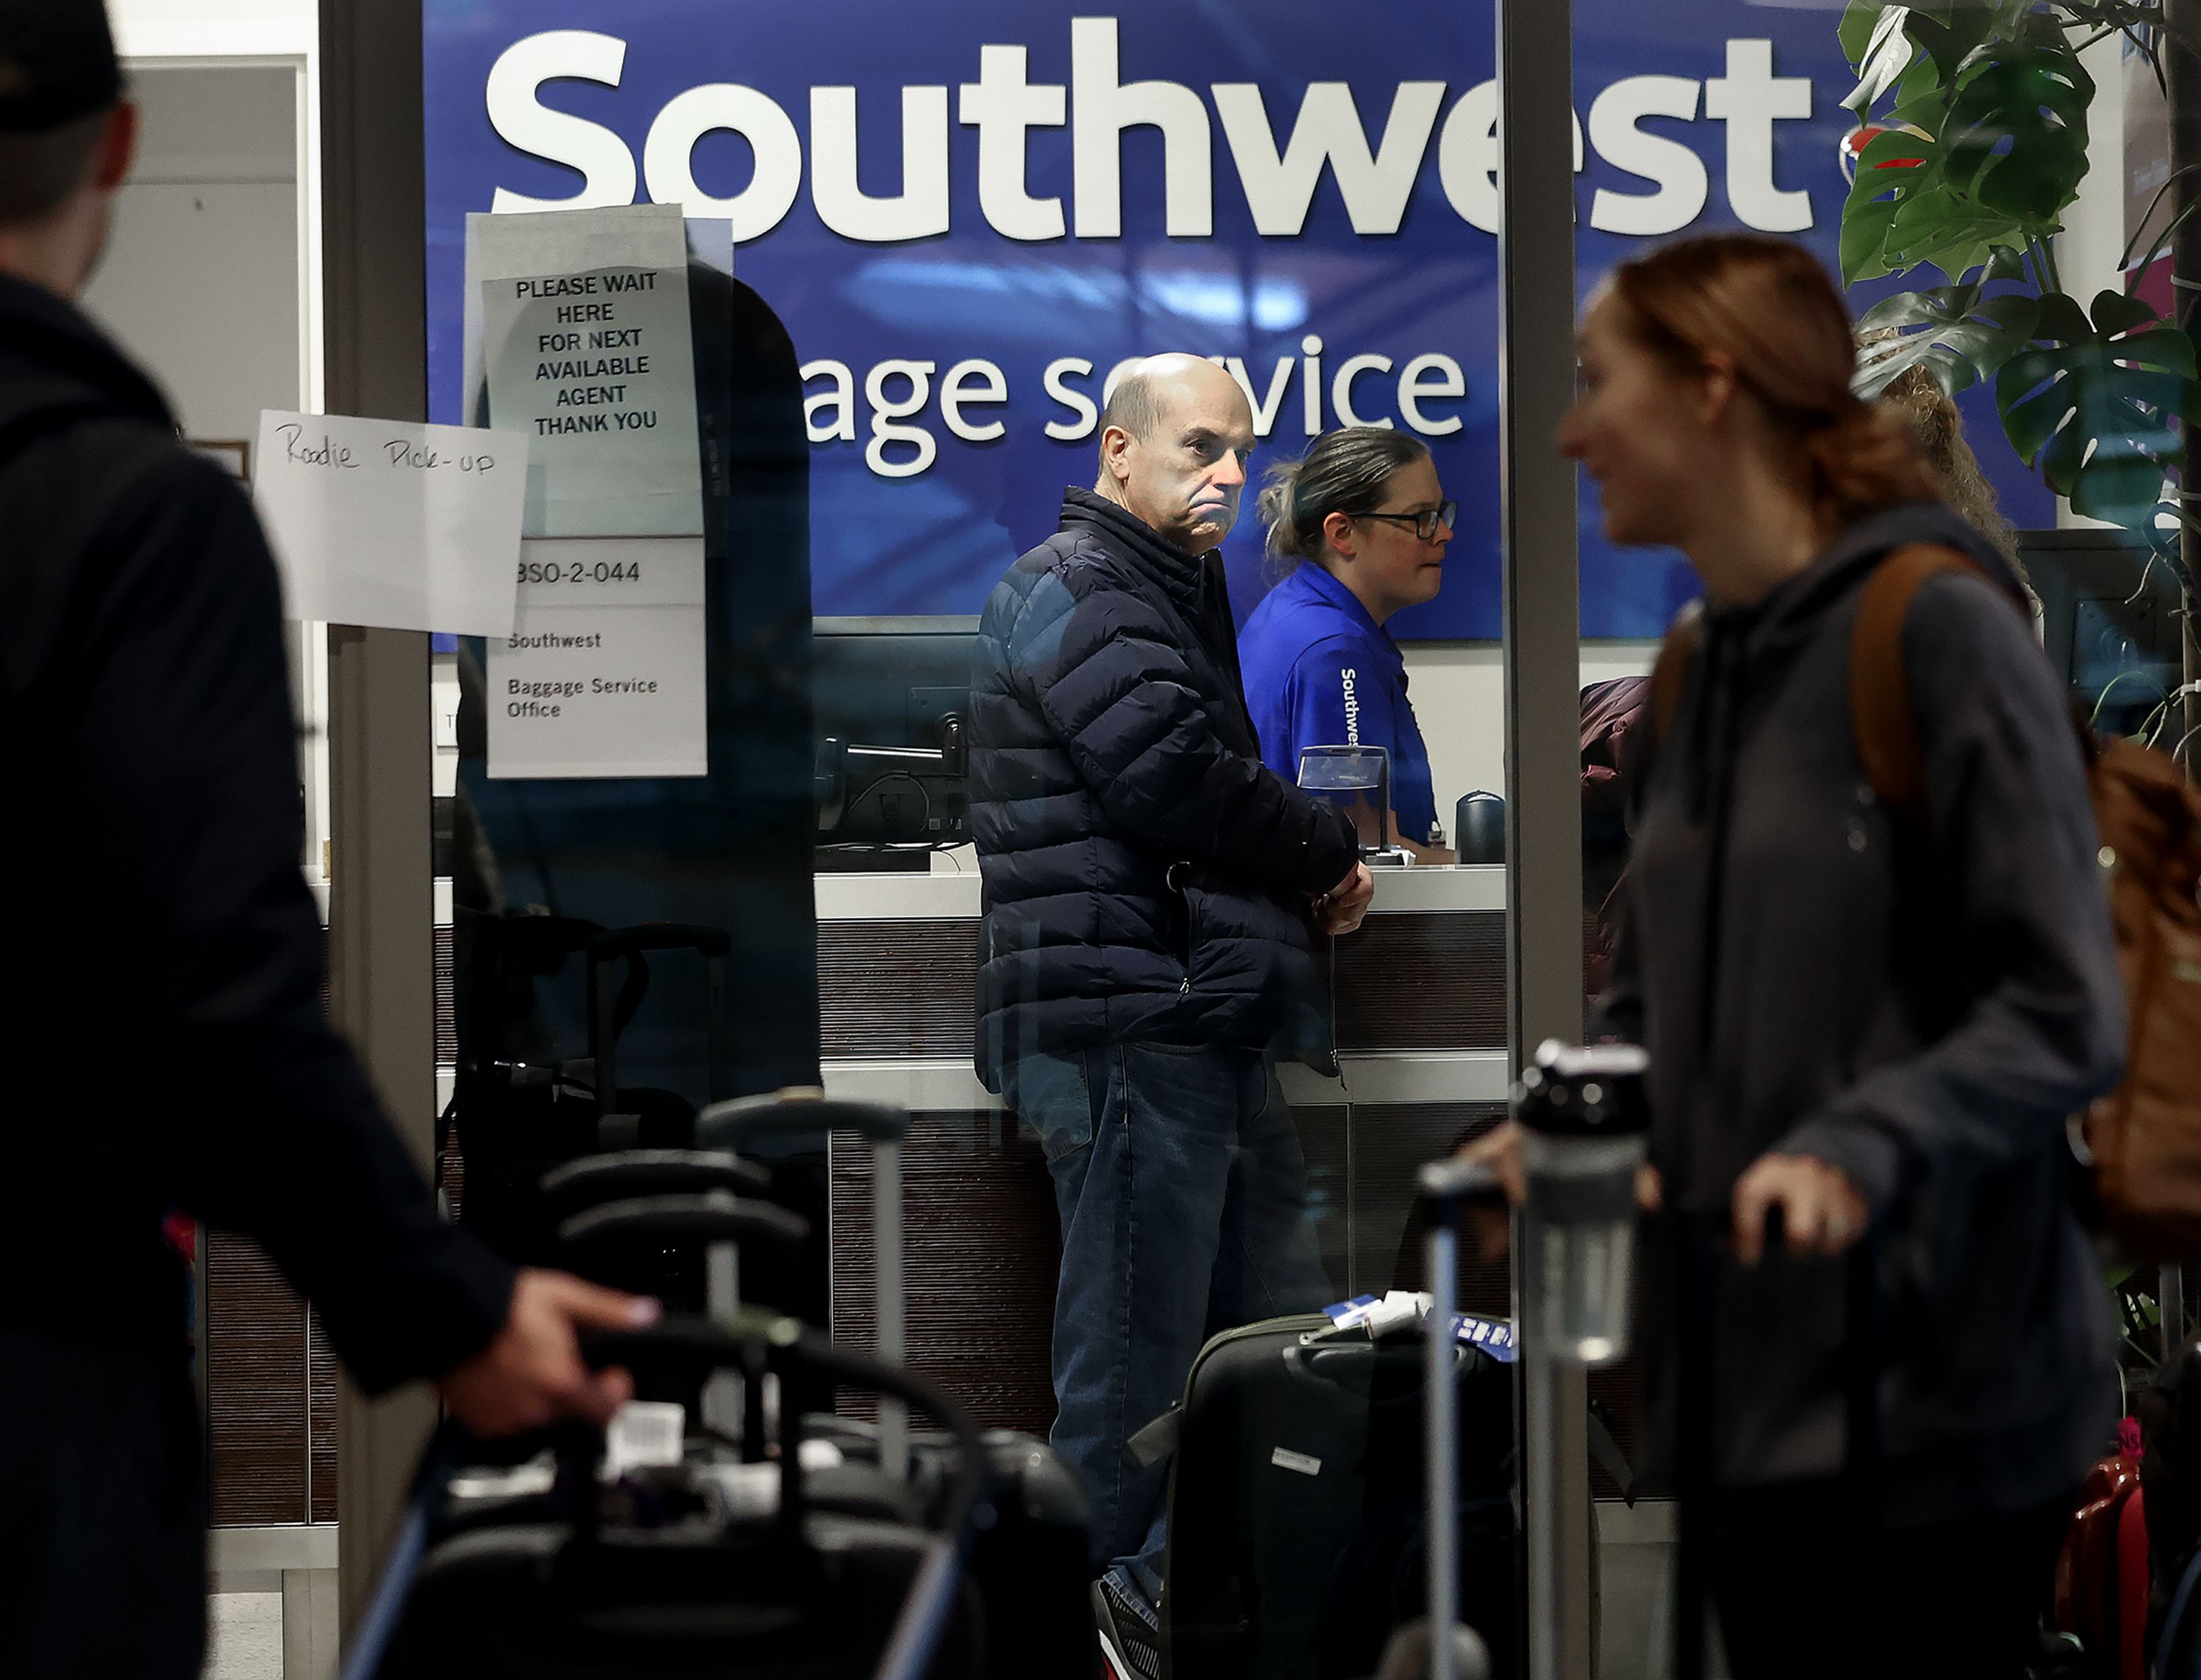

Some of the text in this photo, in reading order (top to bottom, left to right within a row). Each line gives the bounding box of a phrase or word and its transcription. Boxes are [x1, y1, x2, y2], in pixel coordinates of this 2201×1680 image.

[516, 272, 657, 299] PLEASE WAIT
[557, 303, 614, 324] HERE
[539, 329, 643, 353] FOR NEXT
[536, 356, 650, 381] AVAILABLE
[557, 385, 627, 407] AGENT
[534, 411, 657, 436] THANK YOU
[508, 633, 601, 649] Southwest
[508, 677, 657, 698] Baggage Service
[507, 701, 561, 717] Office
